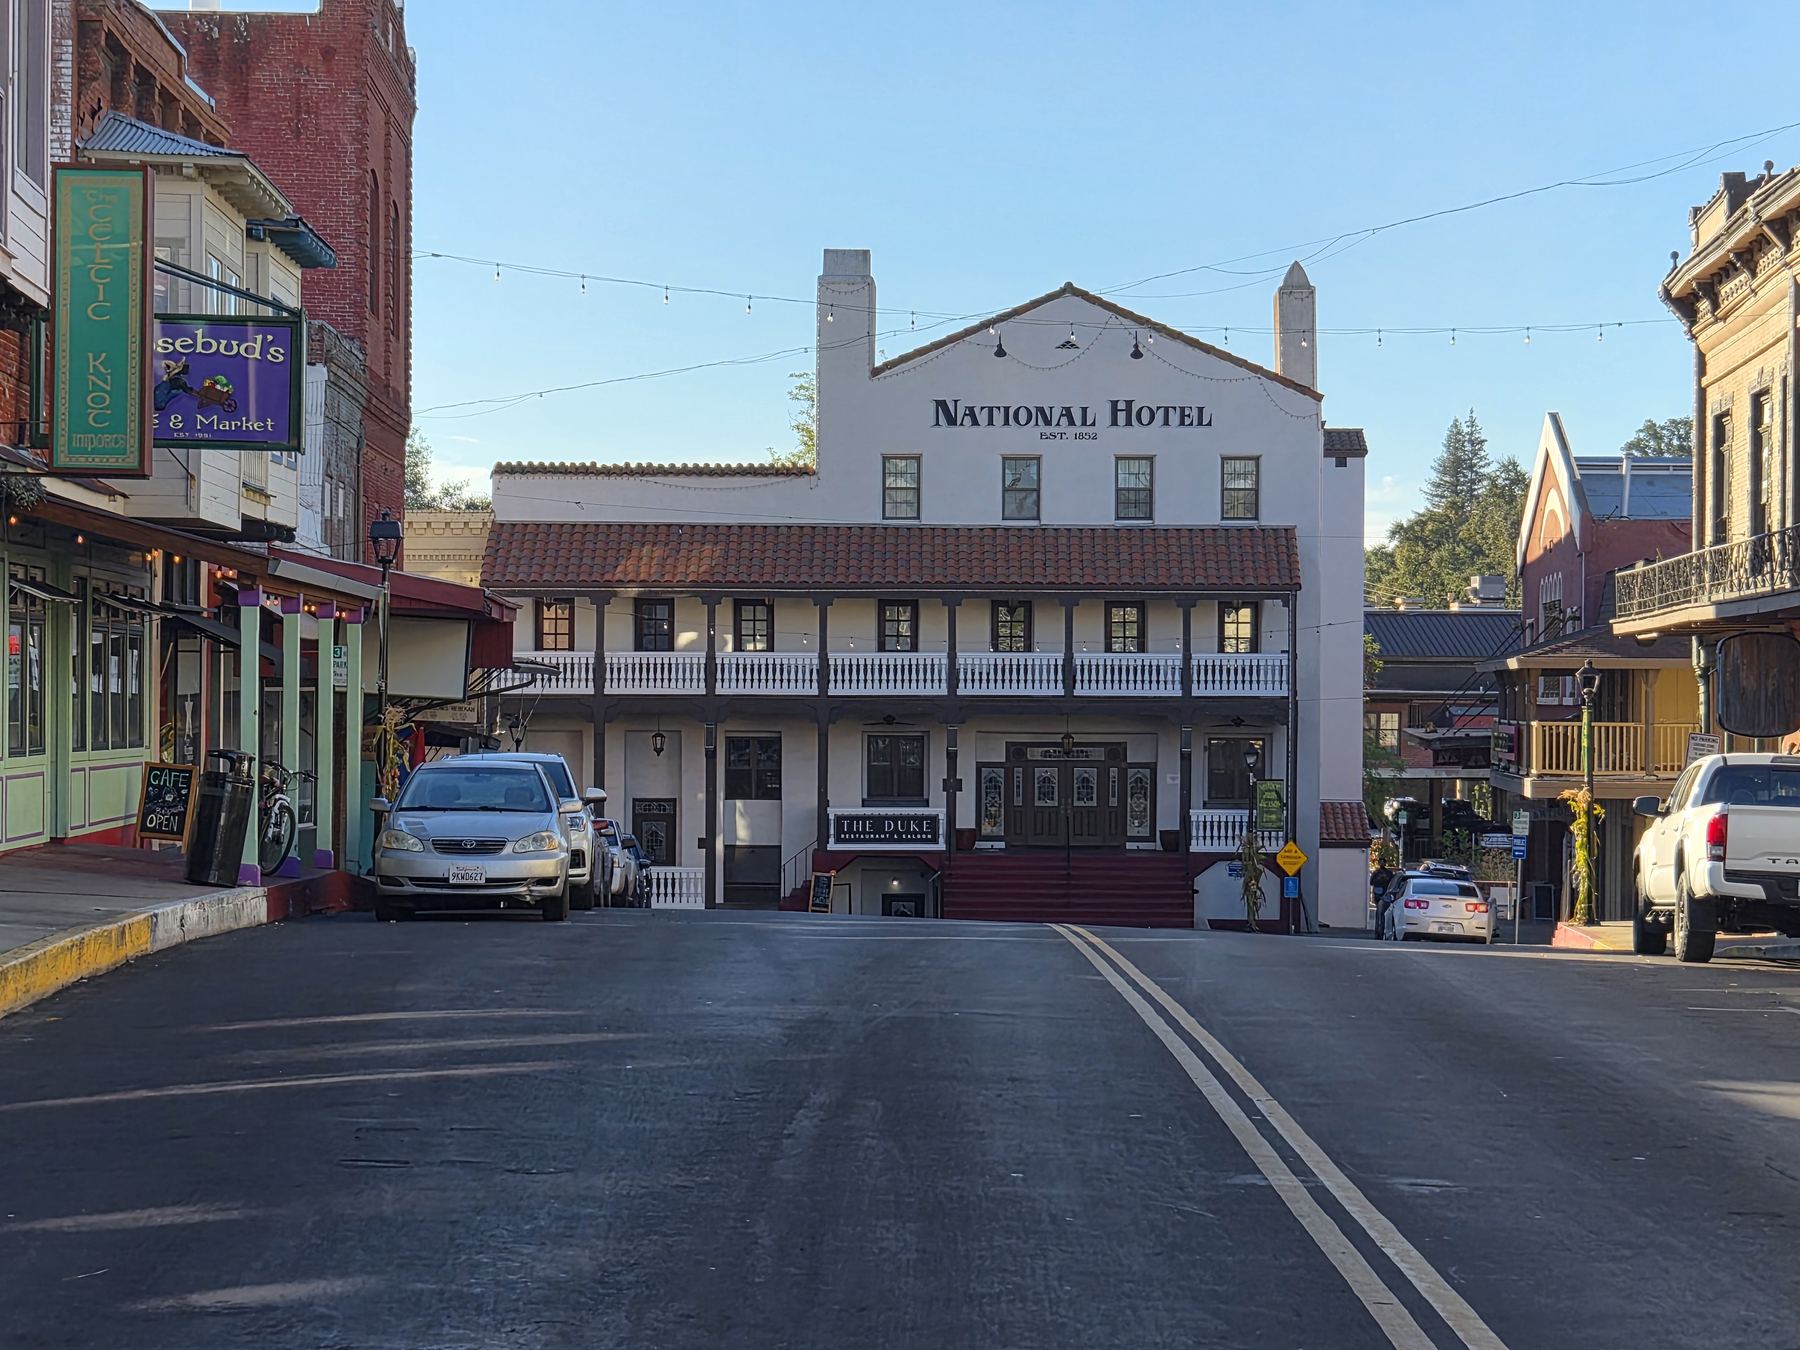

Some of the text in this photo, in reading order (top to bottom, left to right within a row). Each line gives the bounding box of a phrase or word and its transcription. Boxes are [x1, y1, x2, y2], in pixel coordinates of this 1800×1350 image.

[154, 328, 285, 363] sebud's
[169, 413, 184, 429] &
[196, 414, 275, 431] Market
[1040, 432, 1098, 440] EST. 1852
[334, 648, 341, 658] 3
[150, 769, 189, 788] CAFE
[146, 814, 179, 832] OPEN
[841, 820, 932, 832] THE DUKE
